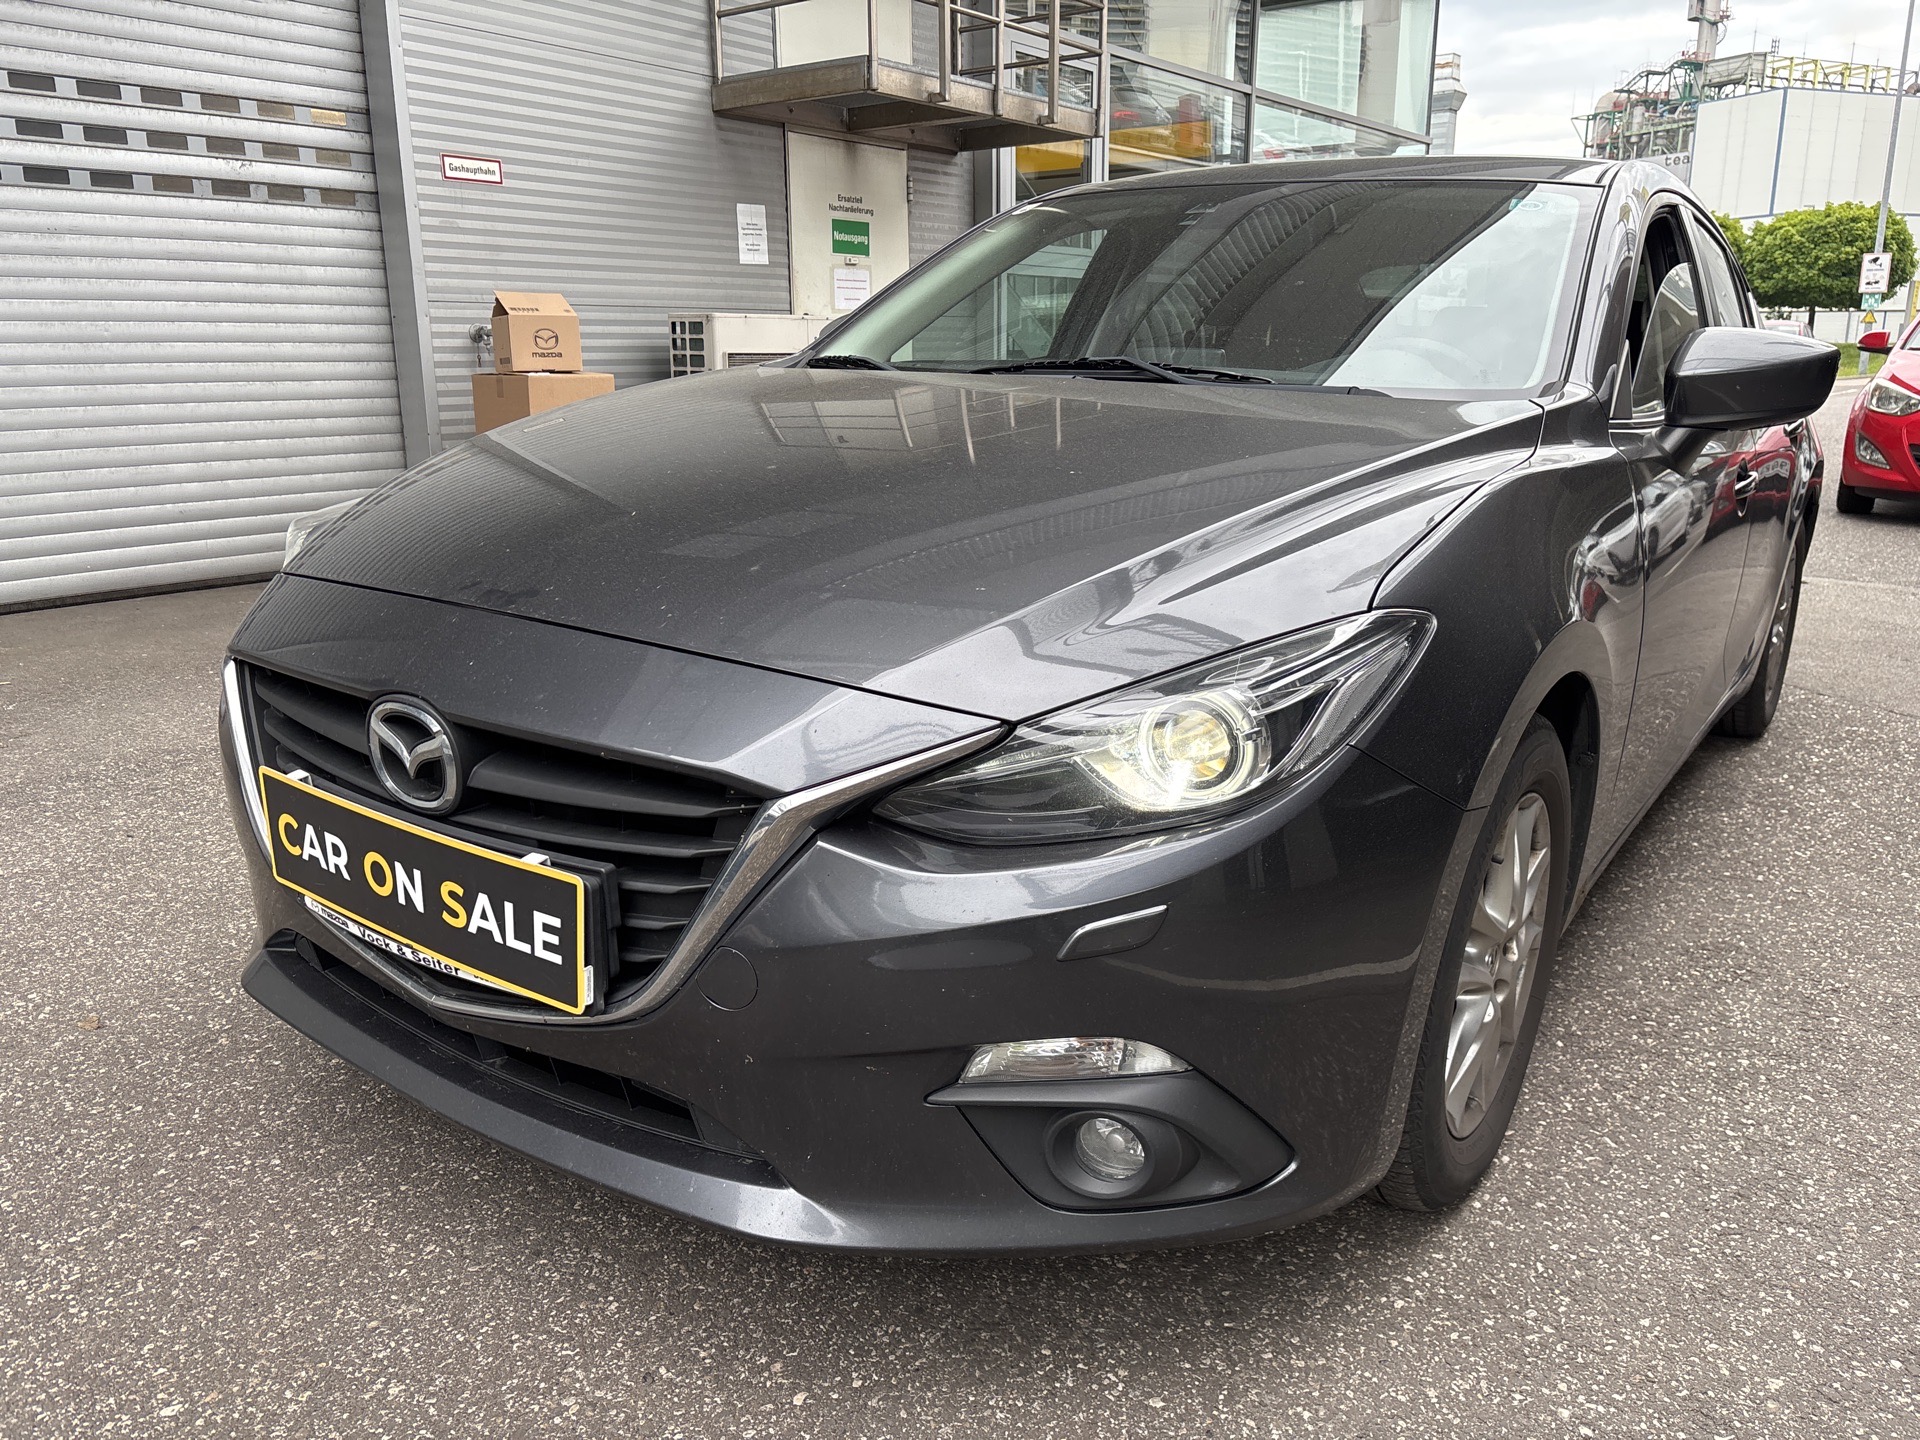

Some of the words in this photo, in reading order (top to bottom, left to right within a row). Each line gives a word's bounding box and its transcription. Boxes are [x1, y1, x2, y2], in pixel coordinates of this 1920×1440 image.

[448, 162, 496, 176] Gashaupthahn
[837, 193, 863, 204] Ersatzteil
[828, 203, 874, 217] Nachtanlieferung
[833, 230, 868, 246] Notausgang
[278, 813, 351, 881] CAR
[363, 851, 424, 914] ON
[440, 881, 562, 966] SALE
[357, 926, 393, 951] Vock
[396, 944, 408, 958] &
[411, 950, 461, 976] Seiter
